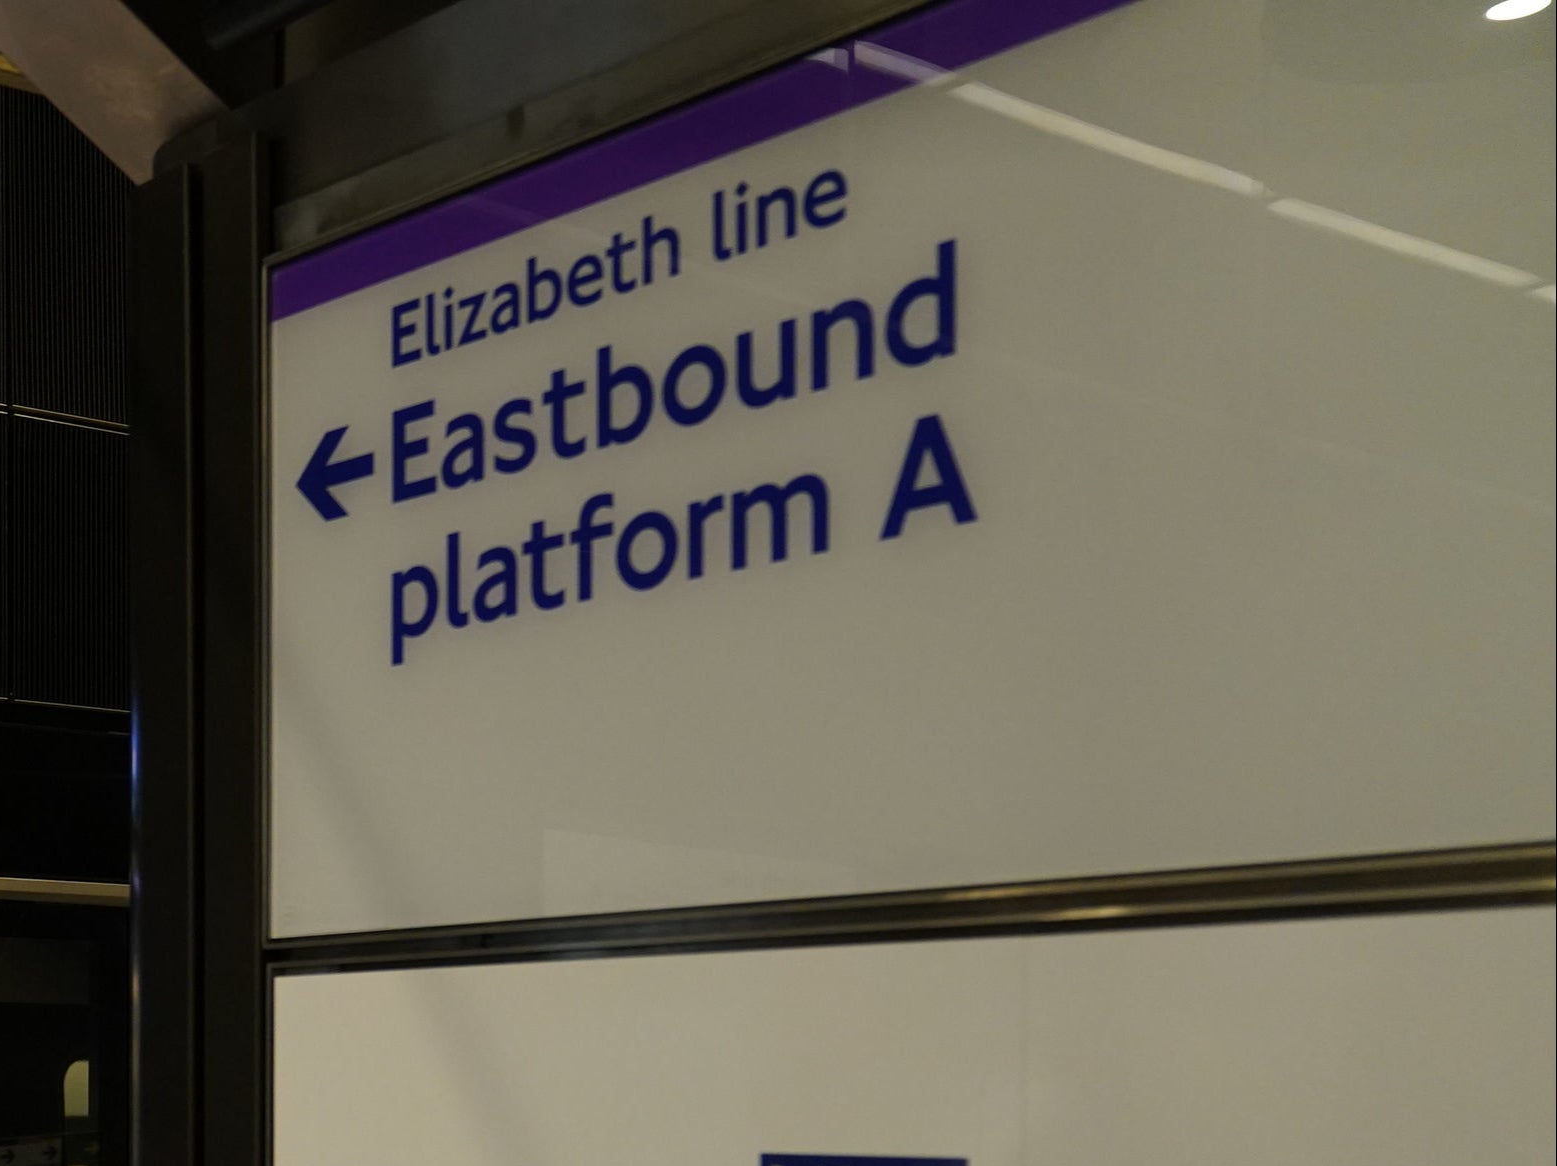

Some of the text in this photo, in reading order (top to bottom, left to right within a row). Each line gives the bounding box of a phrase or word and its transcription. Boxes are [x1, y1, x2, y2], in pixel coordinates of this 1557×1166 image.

[390, 169, 849, 367] Elizabeth line
[390, 240, 958, 504] Eastbound
[390, 414, 978, 666] platform A
